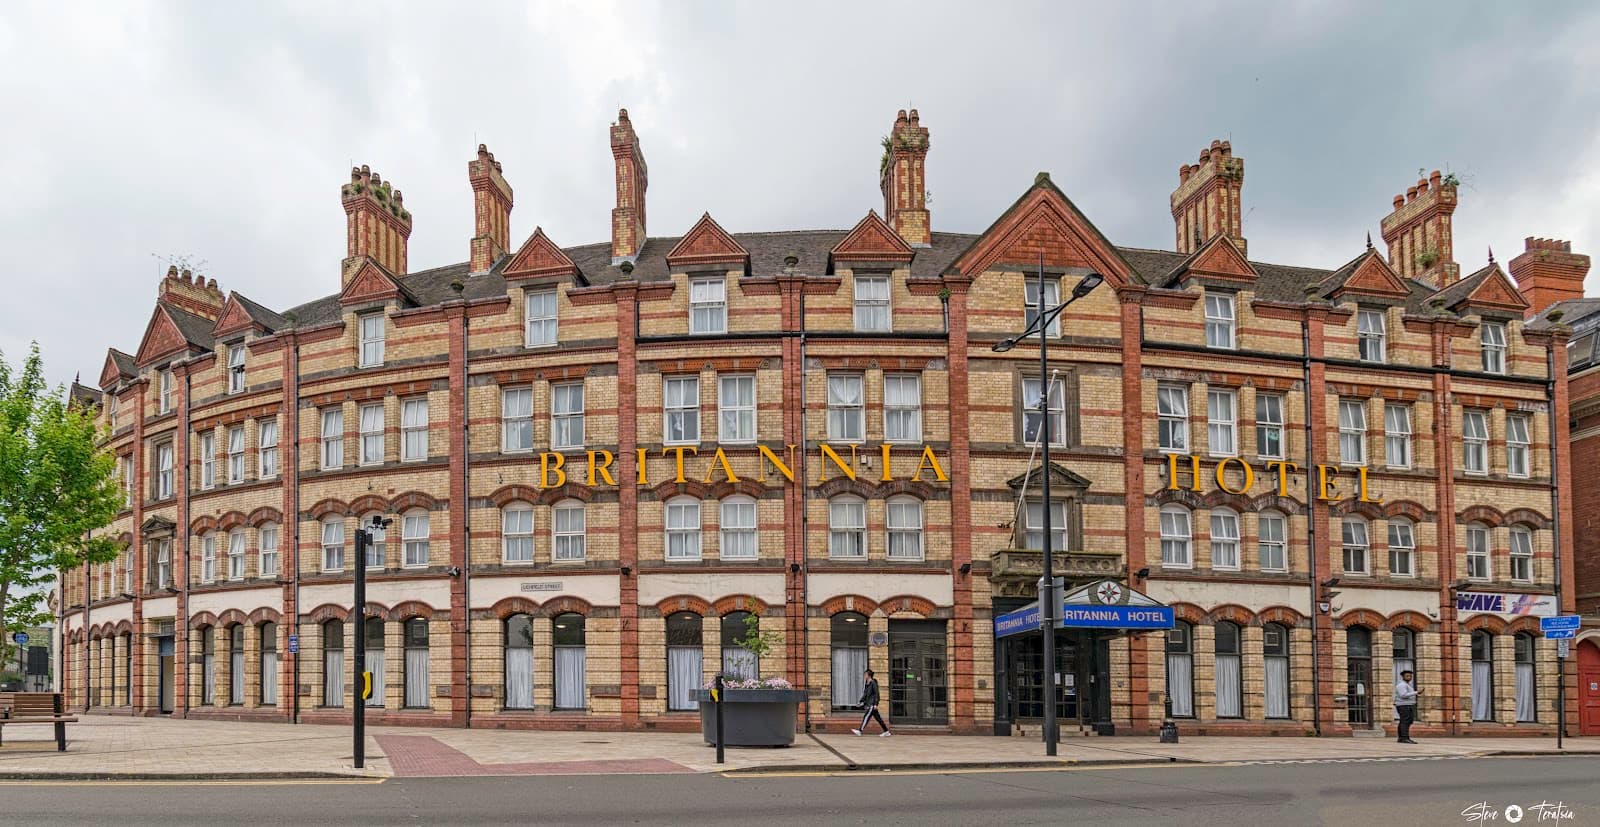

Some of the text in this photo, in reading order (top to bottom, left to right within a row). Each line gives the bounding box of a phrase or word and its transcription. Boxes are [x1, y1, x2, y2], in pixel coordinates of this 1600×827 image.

[539, 443, 1384, 504] BRITANNIA HOTEL
[1457, 594, 1502, 611] WAVE
[997, 612, 1040, 632] BRITANNIA HOTE
[1063, 610, 1167, 622] RITANNIA HOTEL
